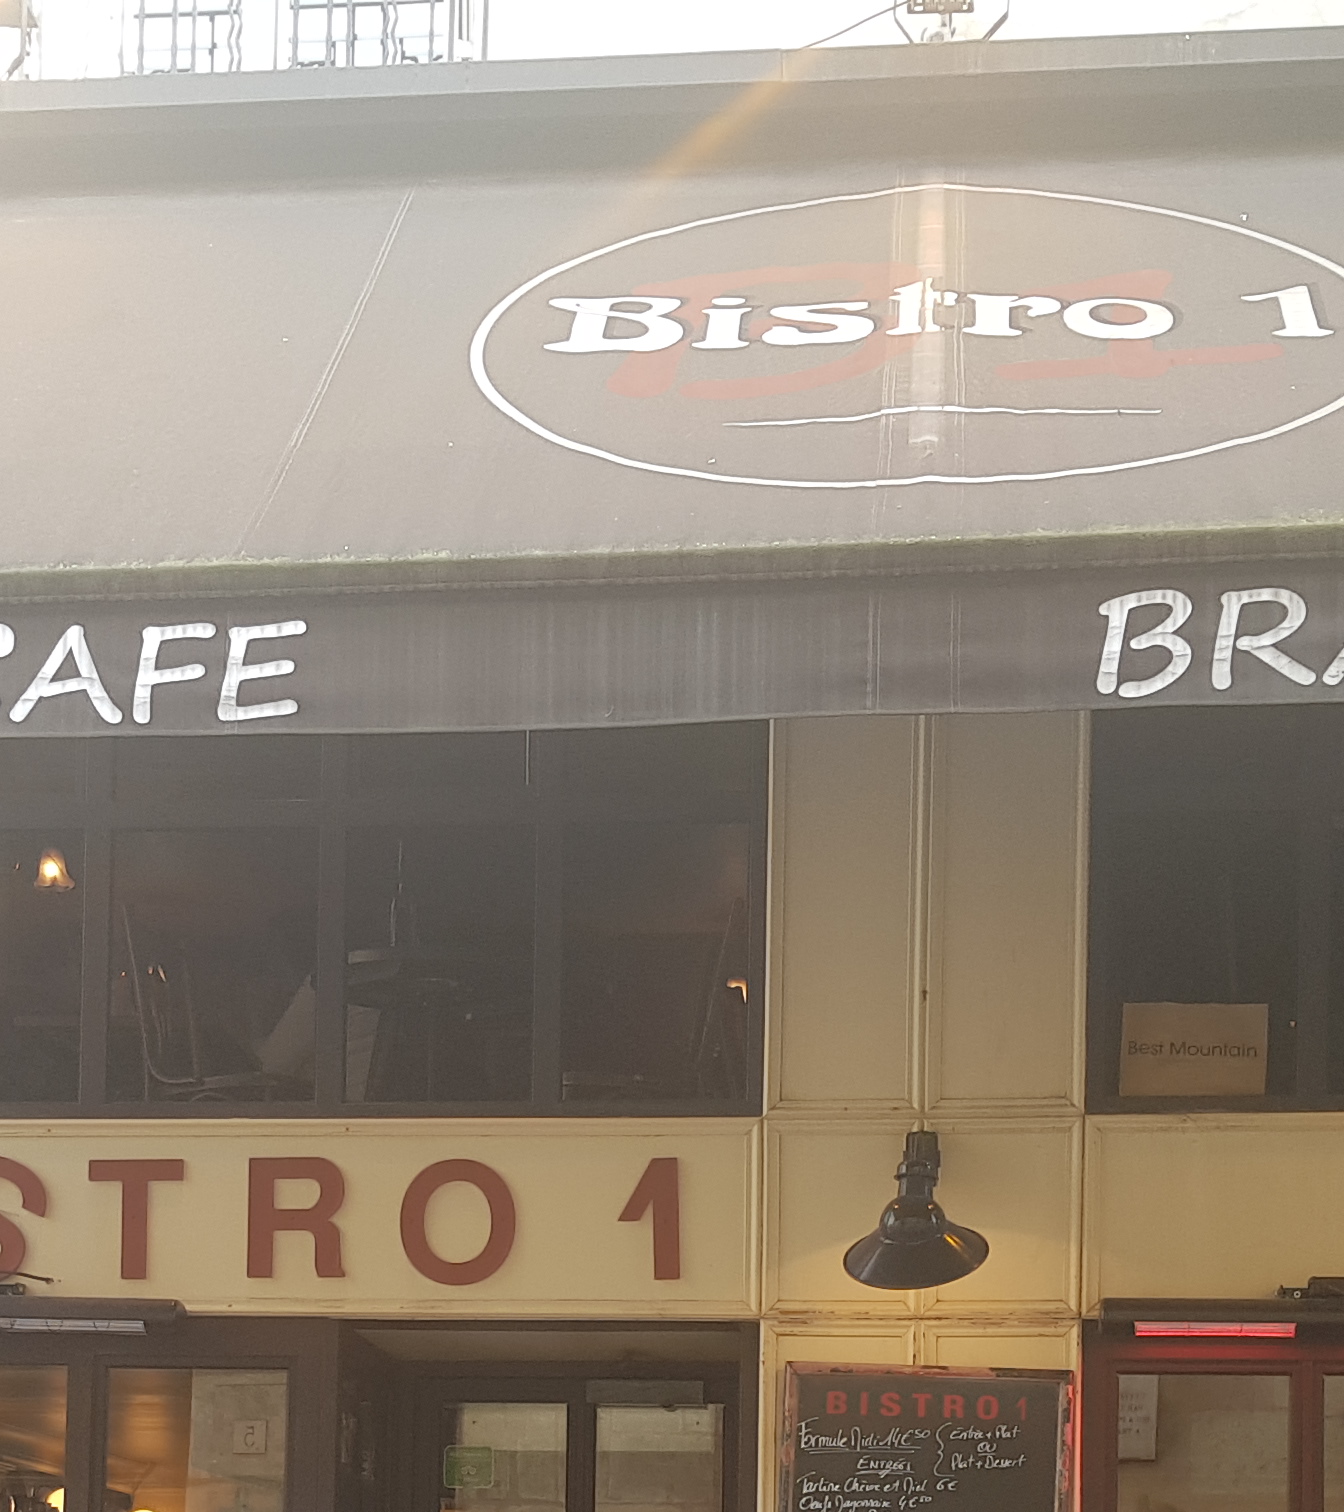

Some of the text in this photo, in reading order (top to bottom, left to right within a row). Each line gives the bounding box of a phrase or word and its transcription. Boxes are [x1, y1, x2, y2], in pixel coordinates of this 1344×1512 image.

[542, 279, 1335, 353] Bistro 1
[1127, 1040, 1258, 1058] Best Mountain
[617, 1156, 681, 1281] 1
[826, 1390, 1028, 1421] BISTRO 1
[797, 1416, 848, 1449] Formule
[797, 1471, 841, 1494] Tartine
[884, 1479, 899, 1492] et
[936, 1478, 958, 1491] 6€
